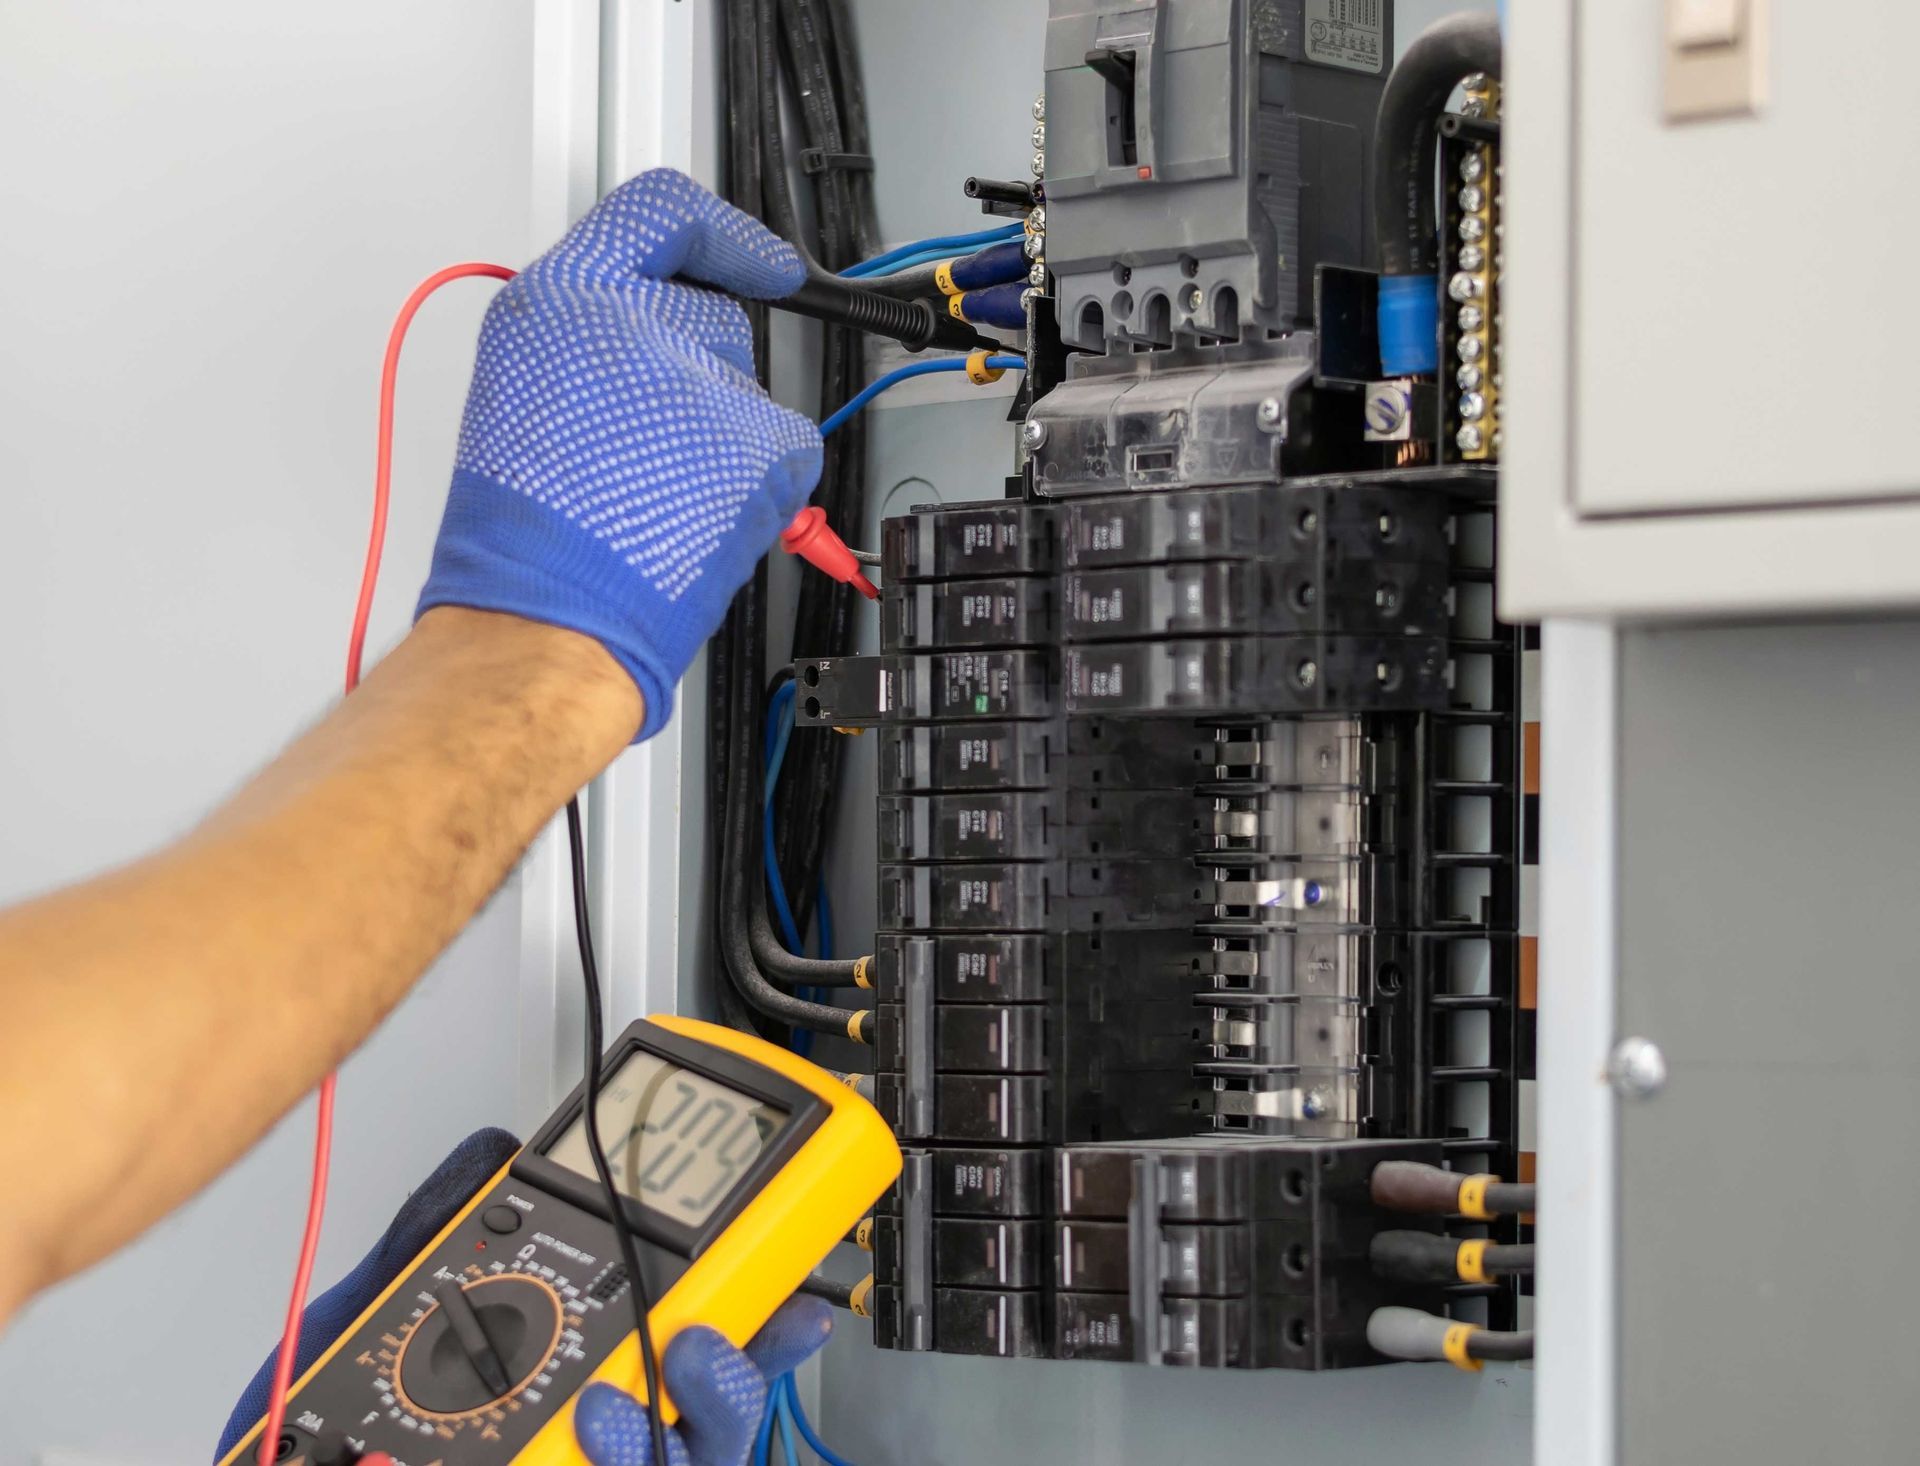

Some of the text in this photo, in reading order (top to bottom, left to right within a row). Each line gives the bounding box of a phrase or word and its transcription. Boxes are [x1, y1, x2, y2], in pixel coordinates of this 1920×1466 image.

[938, 275, 948, 289] 2
[953, 304, 961, 317] 3
[973, 373, 984, 383] 5
[856, 963, 862, 978] 2
[506, 1194, 535, 1213] POWER
[859, 1229, 865, 1242] 3
[296, 1410, 325, 1432] 20A
